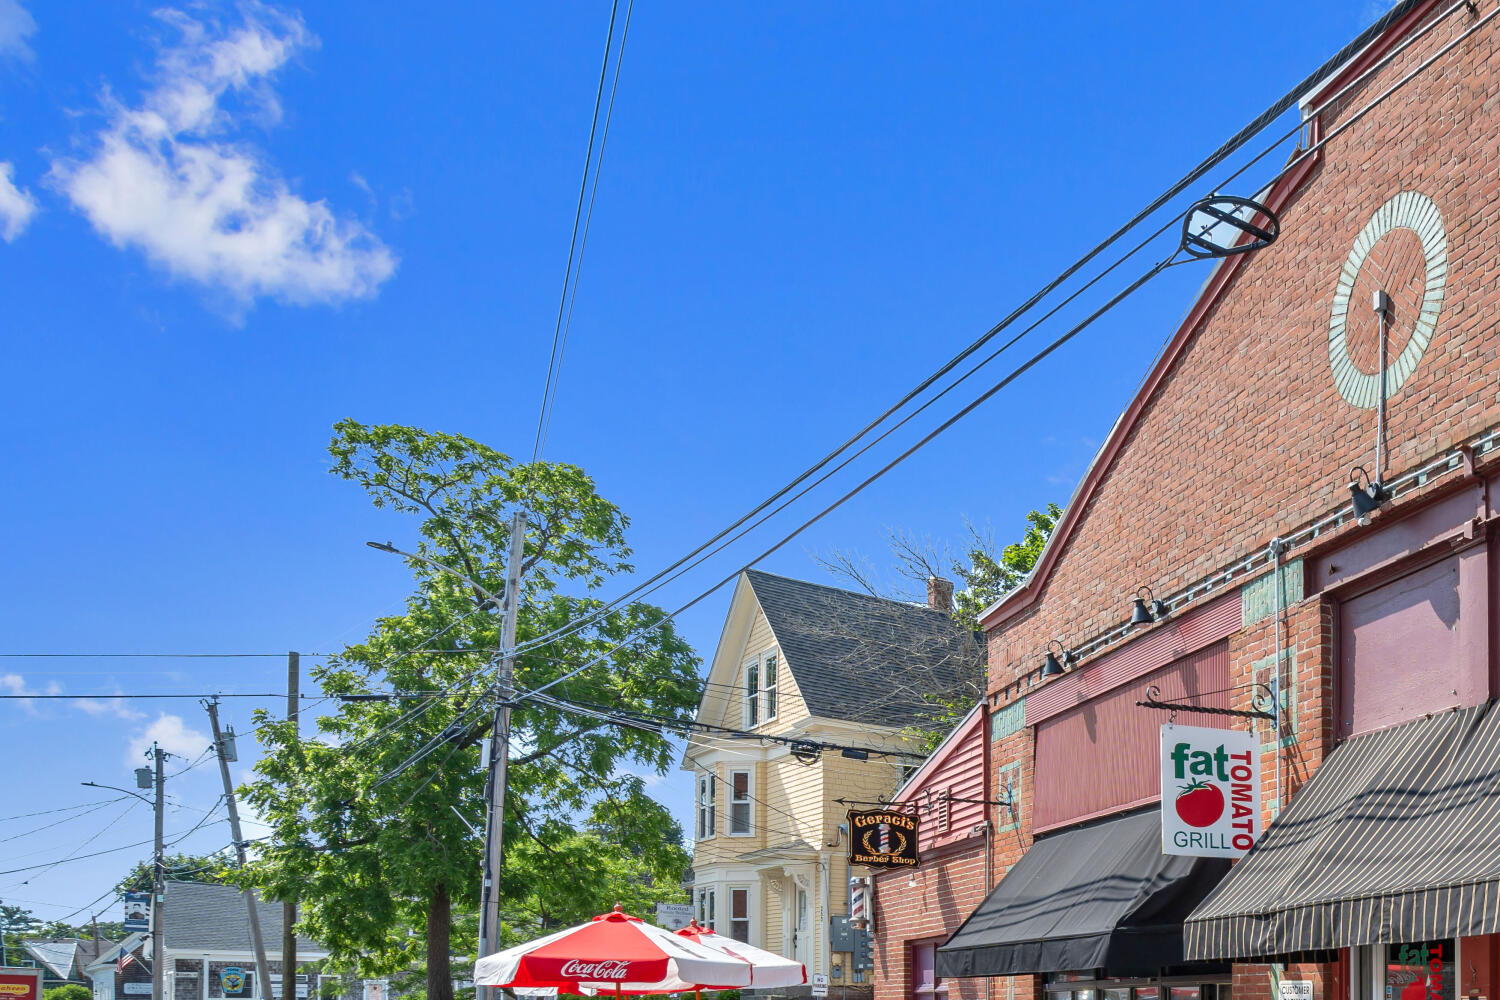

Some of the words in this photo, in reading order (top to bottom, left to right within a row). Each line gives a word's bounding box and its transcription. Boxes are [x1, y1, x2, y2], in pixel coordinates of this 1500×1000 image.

[1170, 743, 1230, 782] fat
[1230, 750, 1254, 851] TOMATO
[854, 815, 915, 830] Geraci's
[1173, 831, 1231, 849] GRILL
[855, 854, 889, 863] Barber
[892, 856, 916, 865] Shop
[1399, 942, 1430, 972] fat
[560, 958, 633, 979] Coca-Cola
[1281, 985, 1310, 995] CUSTOMER
